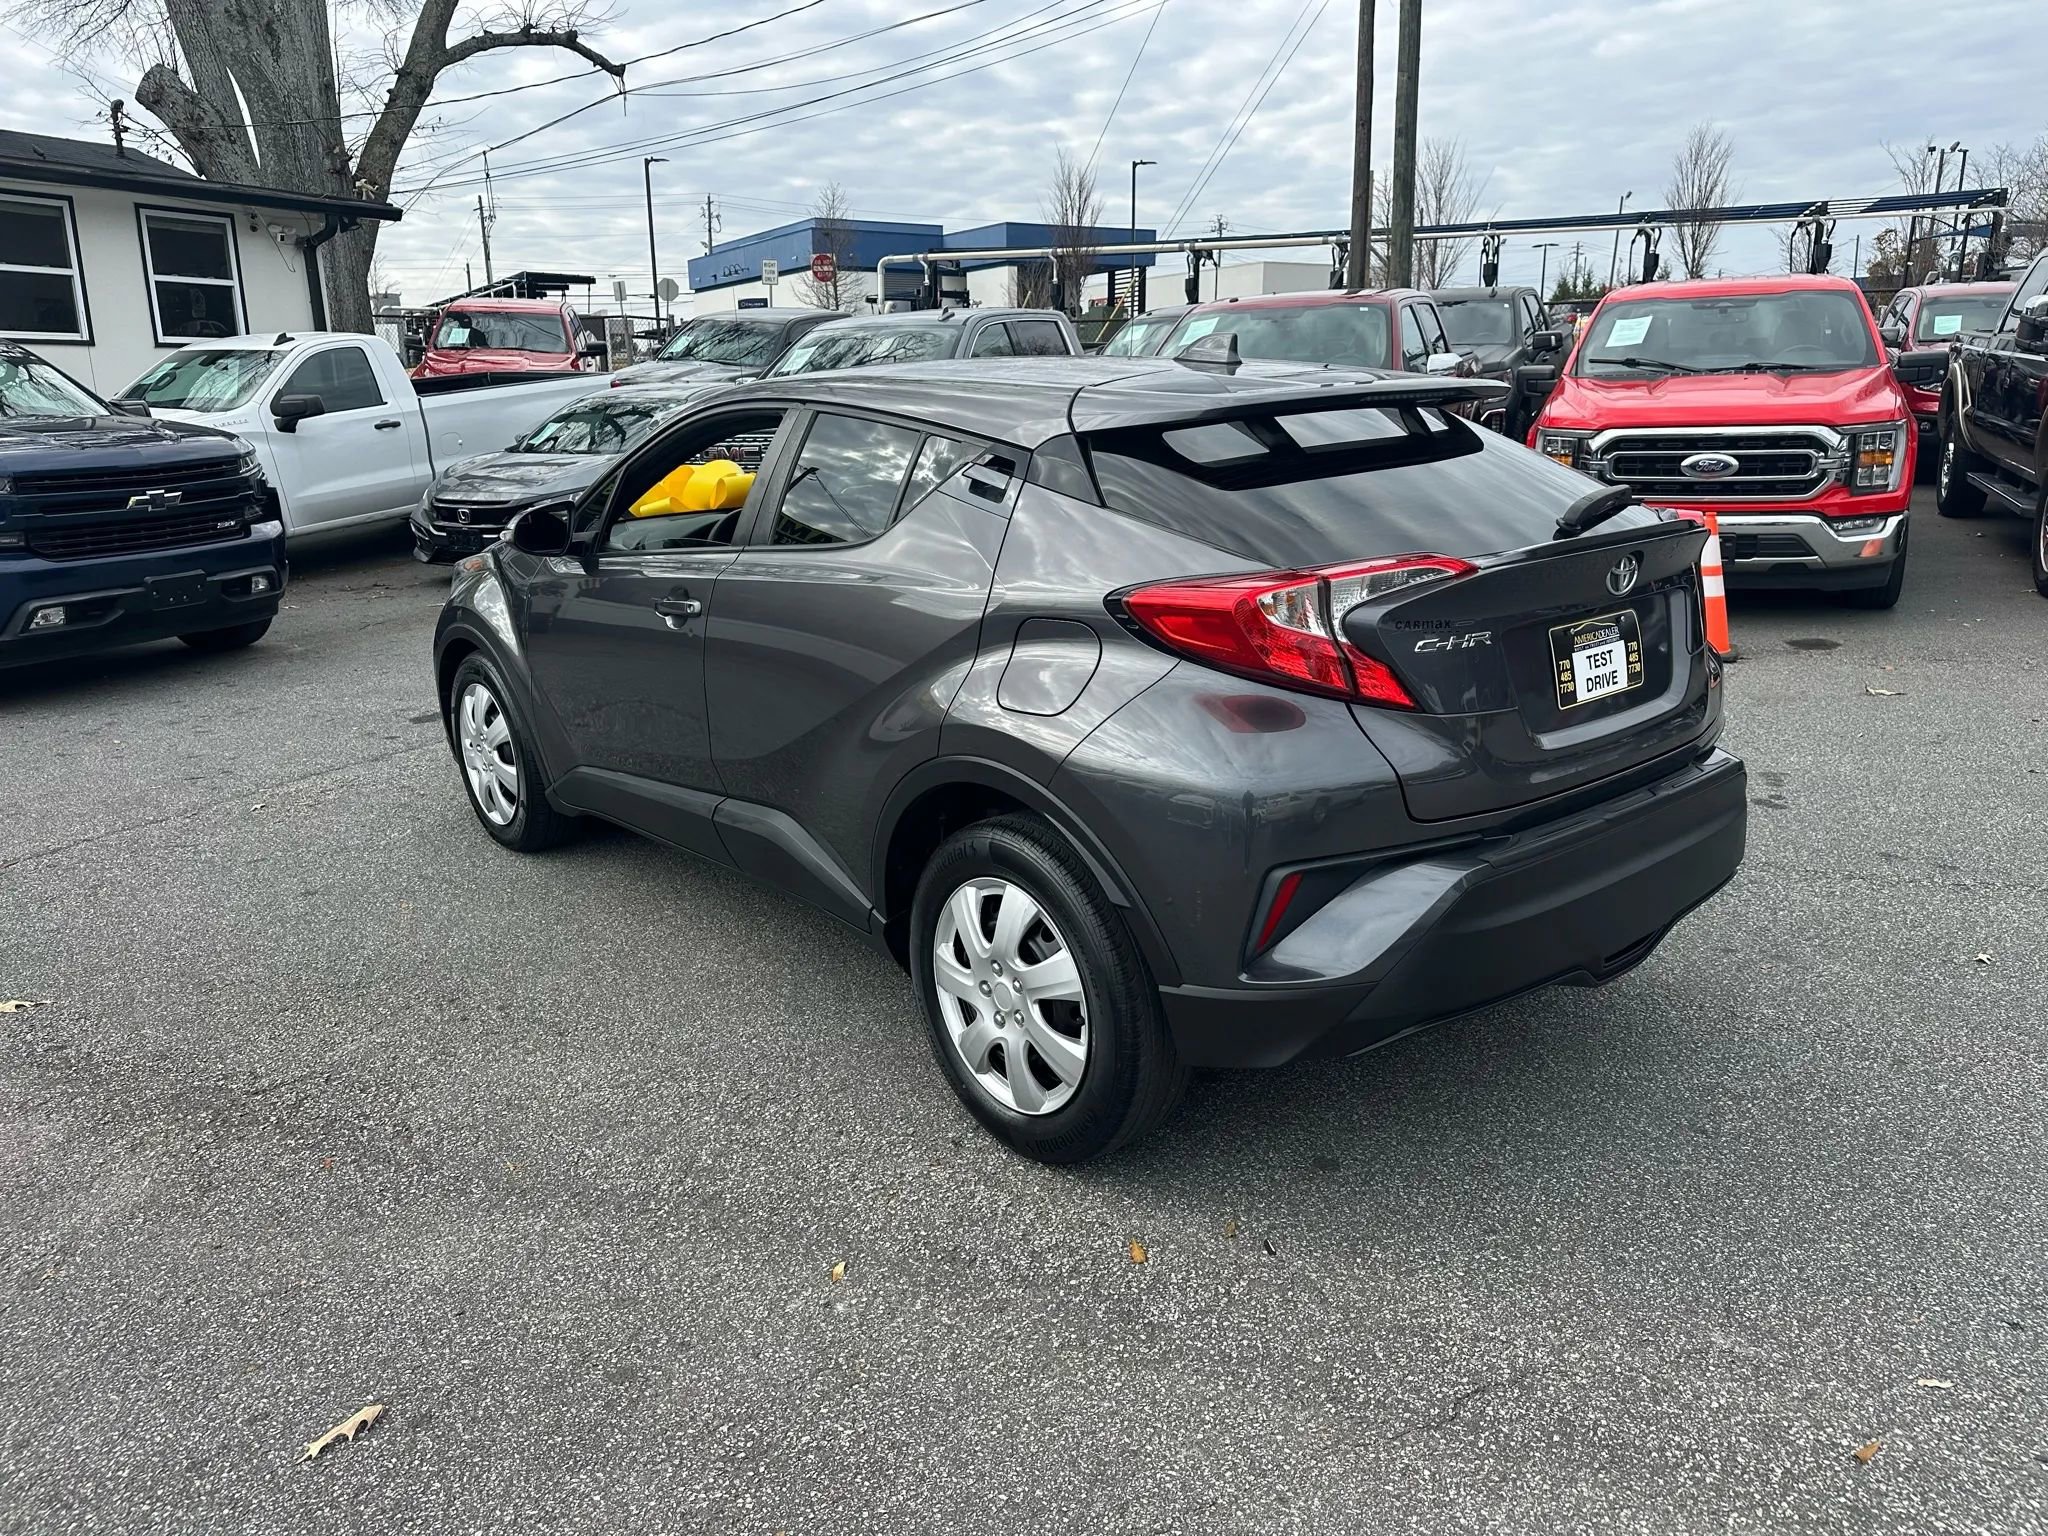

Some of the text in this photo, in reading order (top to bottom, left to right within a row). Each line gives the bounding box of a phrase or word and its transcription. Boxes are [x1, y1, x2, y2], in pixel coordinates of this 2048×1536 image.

[700, 446, 761, 461] GMC
[1695, 459, 1725, 472] Ford
[1414, 631, 1493, 653] C-HR
[1627, 641, 1638, 652] 770
[1586, 650, 1614, 670] TEST
[1628, 652, 1639, 663] 485
[1559, 660, 1571, 671] 770
[1628, 663, 1641, 674] 7730
[1560, 671, 1572, 682] 485
[1586, 670, 1618, 693] DRIVE
[1560, 682, 1575, 694] 7730
